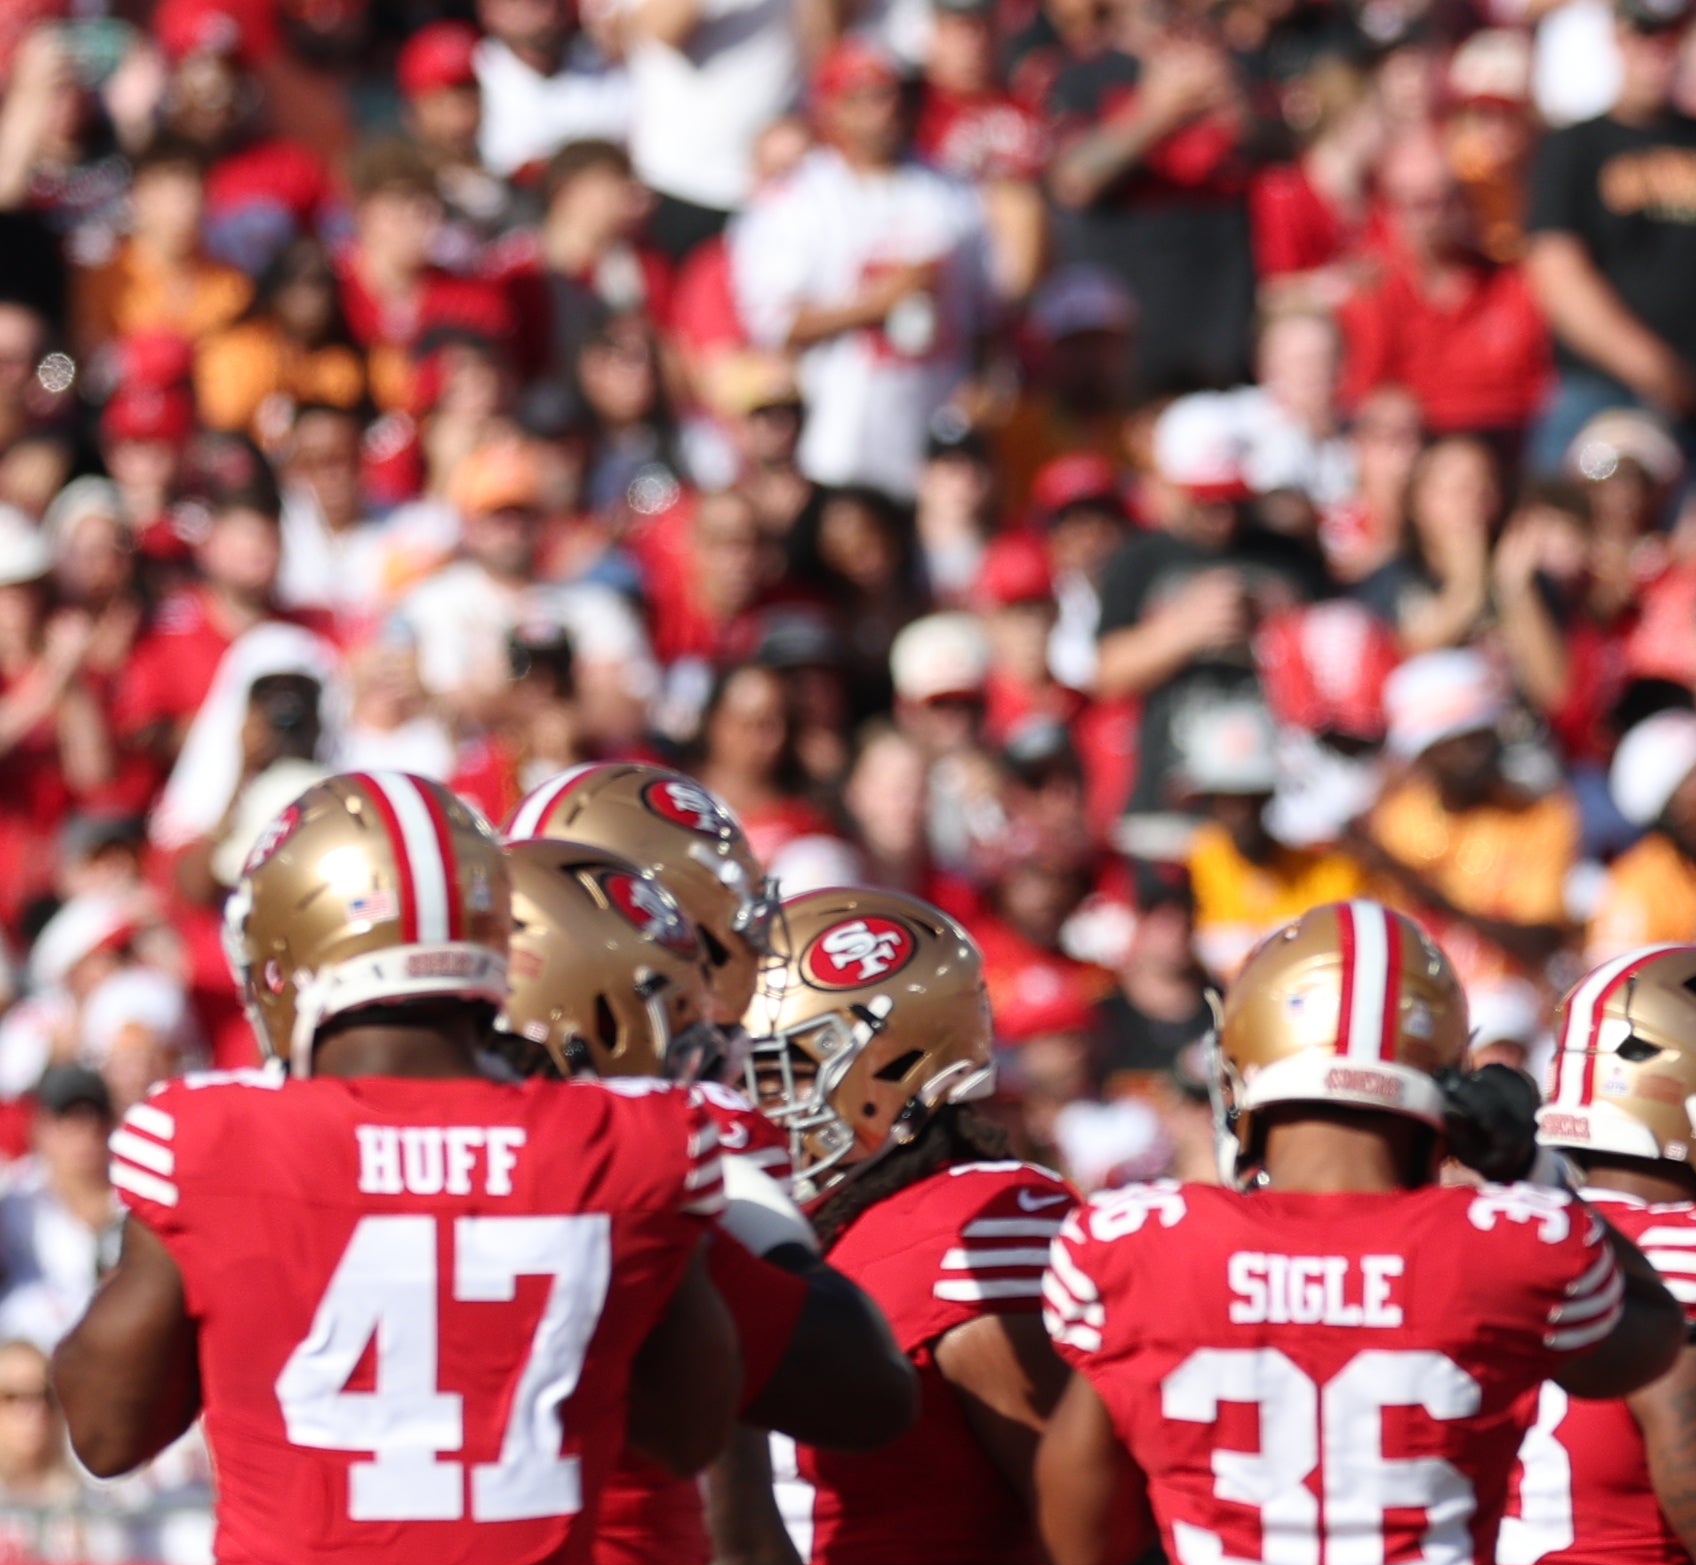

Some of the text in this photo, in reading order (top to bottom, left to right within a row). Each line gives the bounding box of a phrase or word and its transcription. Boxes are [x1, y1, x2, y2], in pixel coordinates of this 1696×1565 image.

[355, 1124, 527, 1196] HUFF
[1228, 1251, 1404, 1328] SIGLE
[275, 1214, 610, 1522] 47
